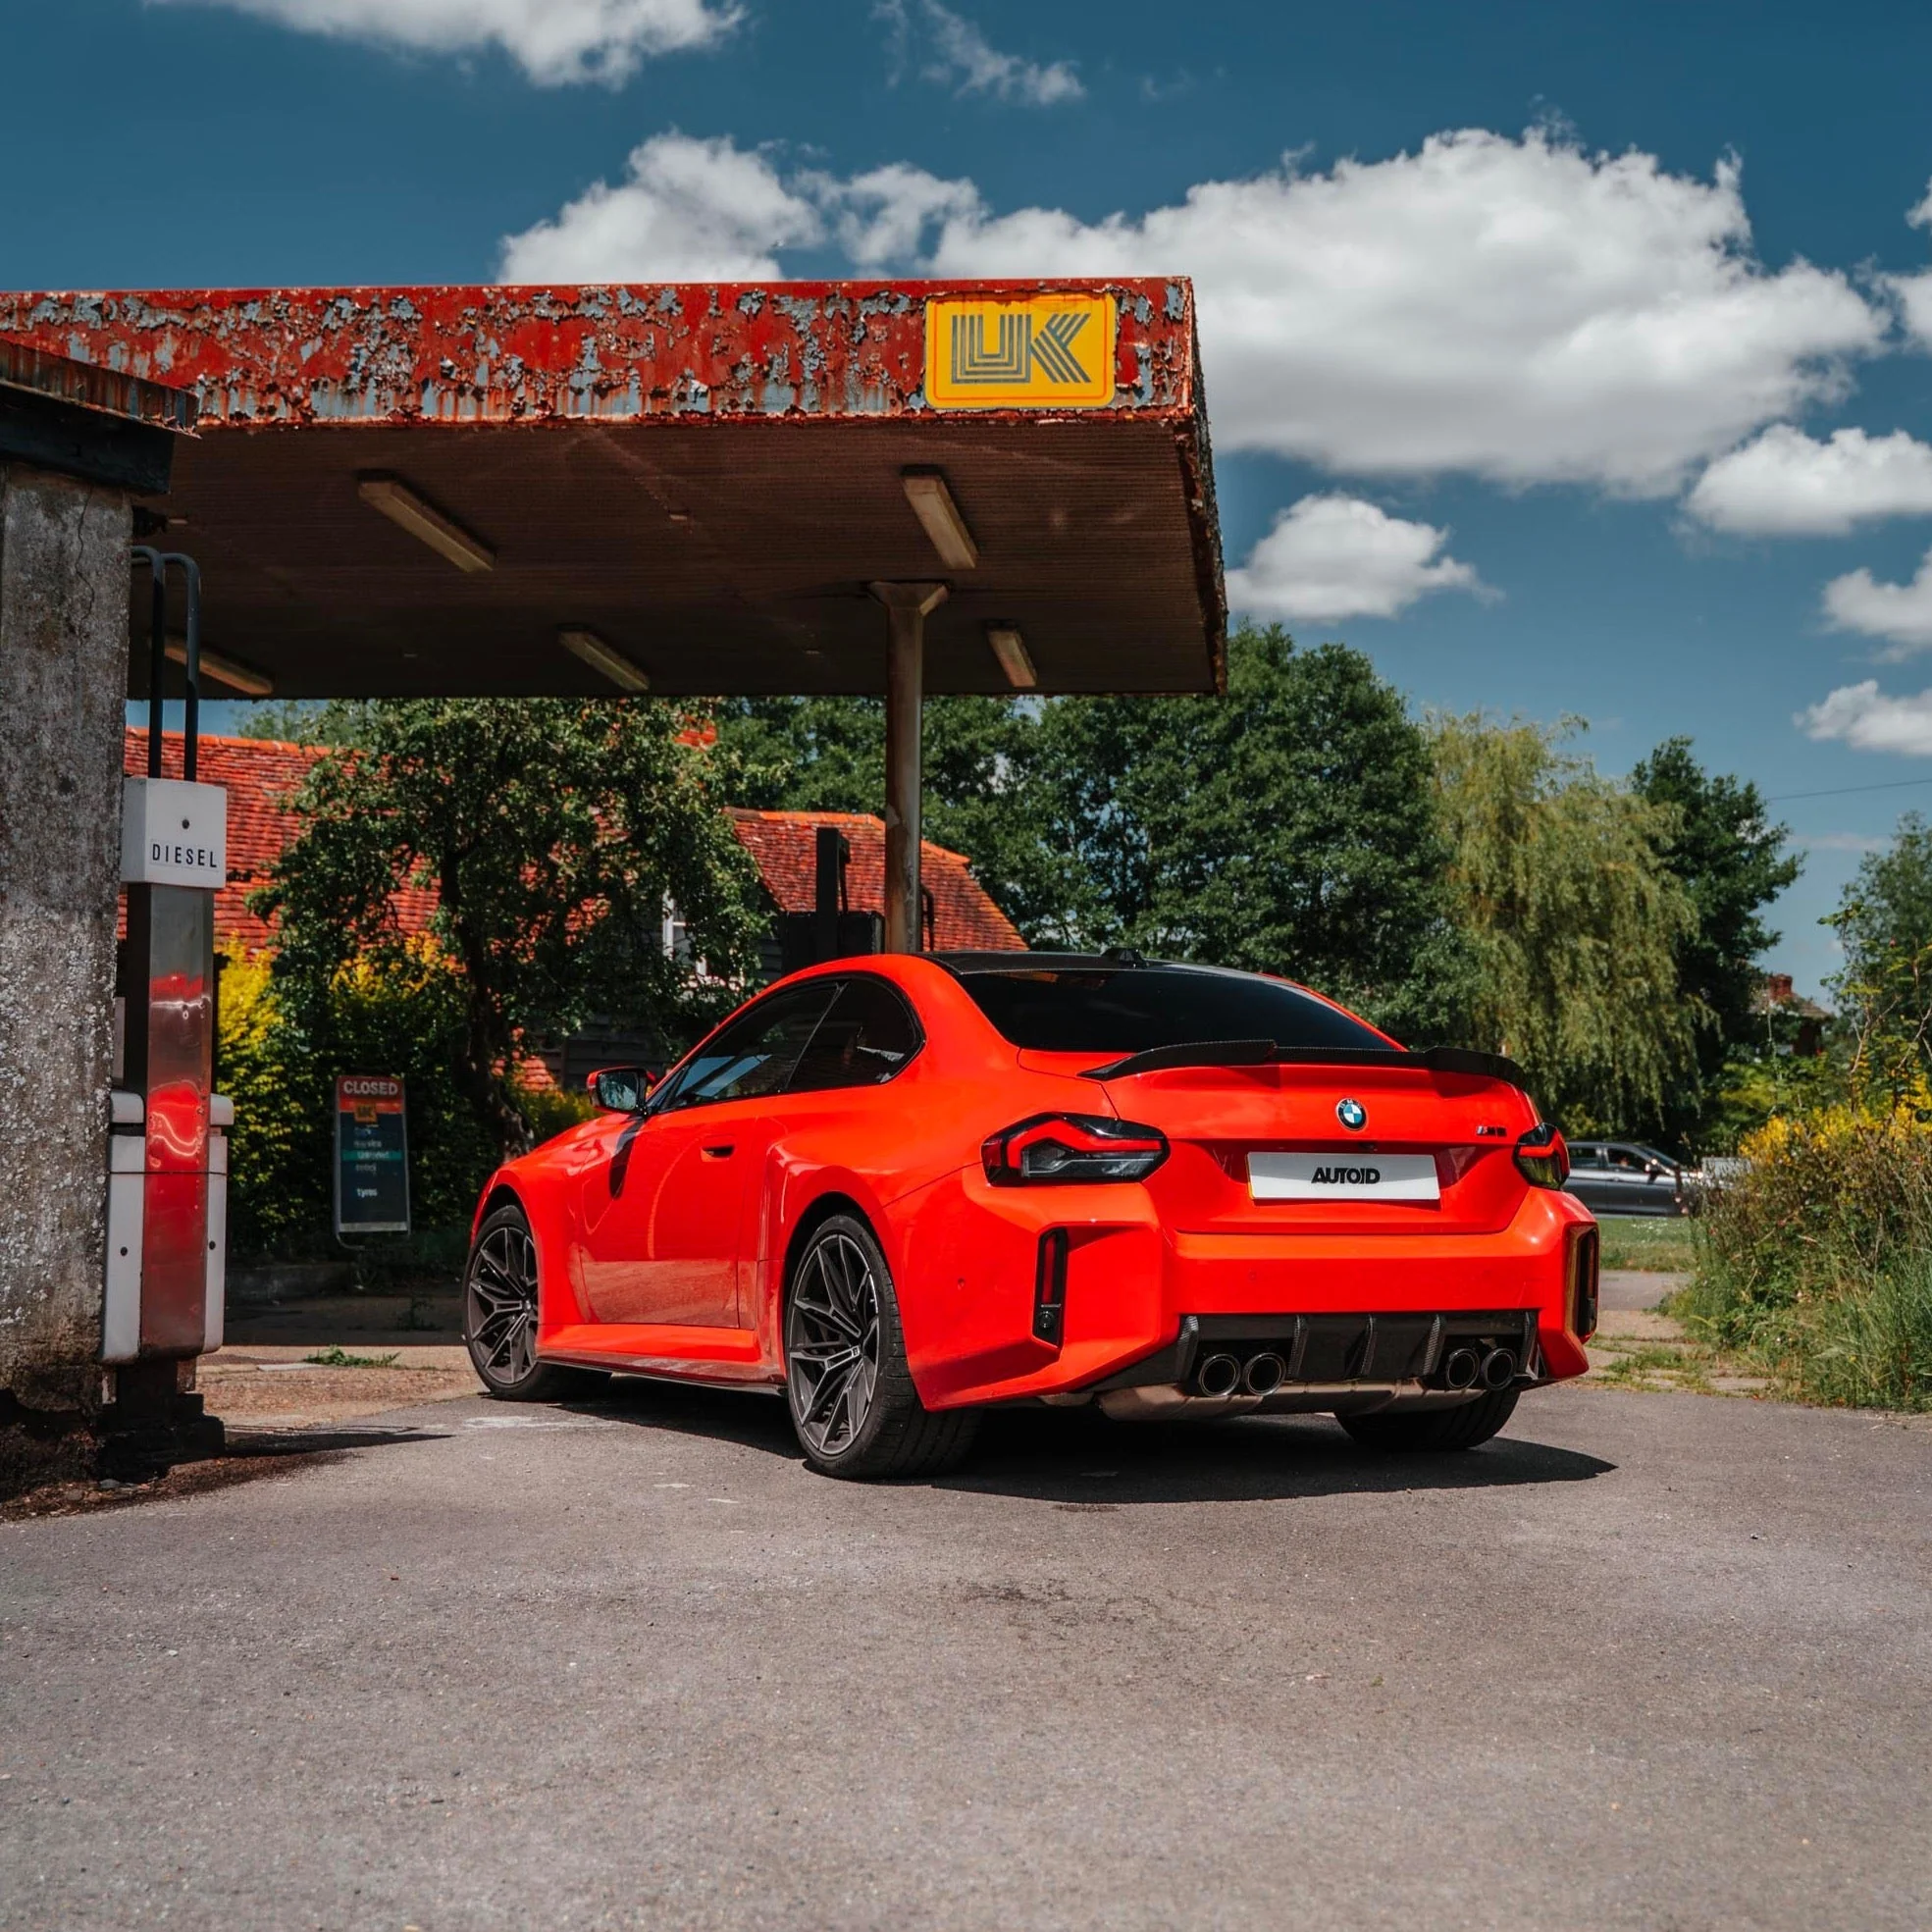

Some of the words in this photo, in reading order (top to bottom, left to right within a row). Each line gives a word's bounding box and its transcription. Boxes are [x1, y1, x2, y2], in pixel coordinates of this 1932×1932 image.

[951, 313, 1091, 384] UK
[152, 844, 217, 867] DIESEL
[343, 1079, 398, 1096] CLOSED
[1311, 1167, 1381, 1184] AUTOID
